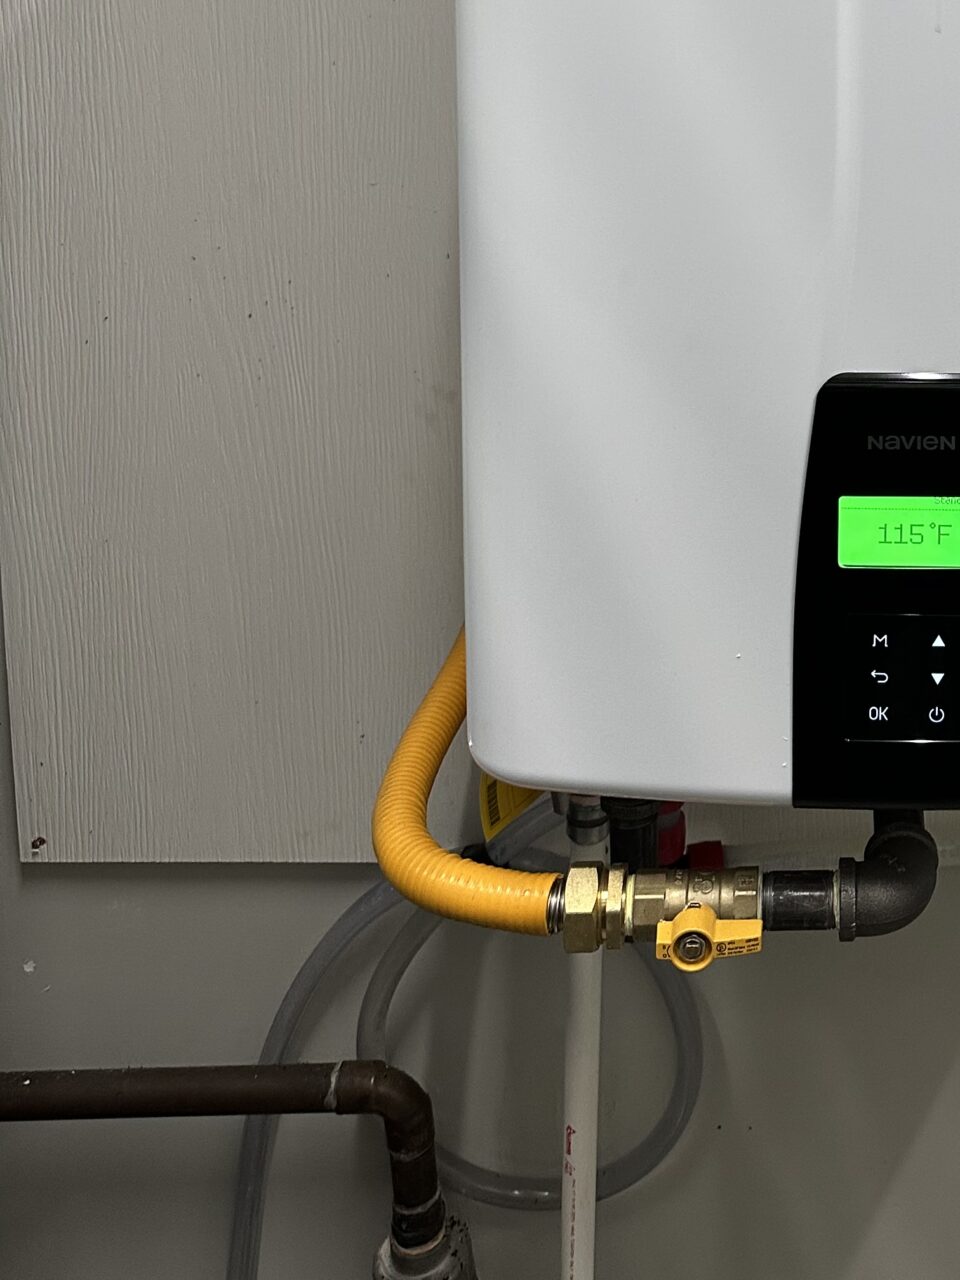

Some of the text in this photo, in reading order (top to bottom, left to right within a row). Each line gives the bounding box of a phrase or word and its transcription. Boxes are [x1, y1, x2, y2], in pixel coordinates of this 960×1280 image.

[878, 522, 953, 546] 115°F
[872, 634, 889, 648] M
[869, 707, 889, 721] OK
